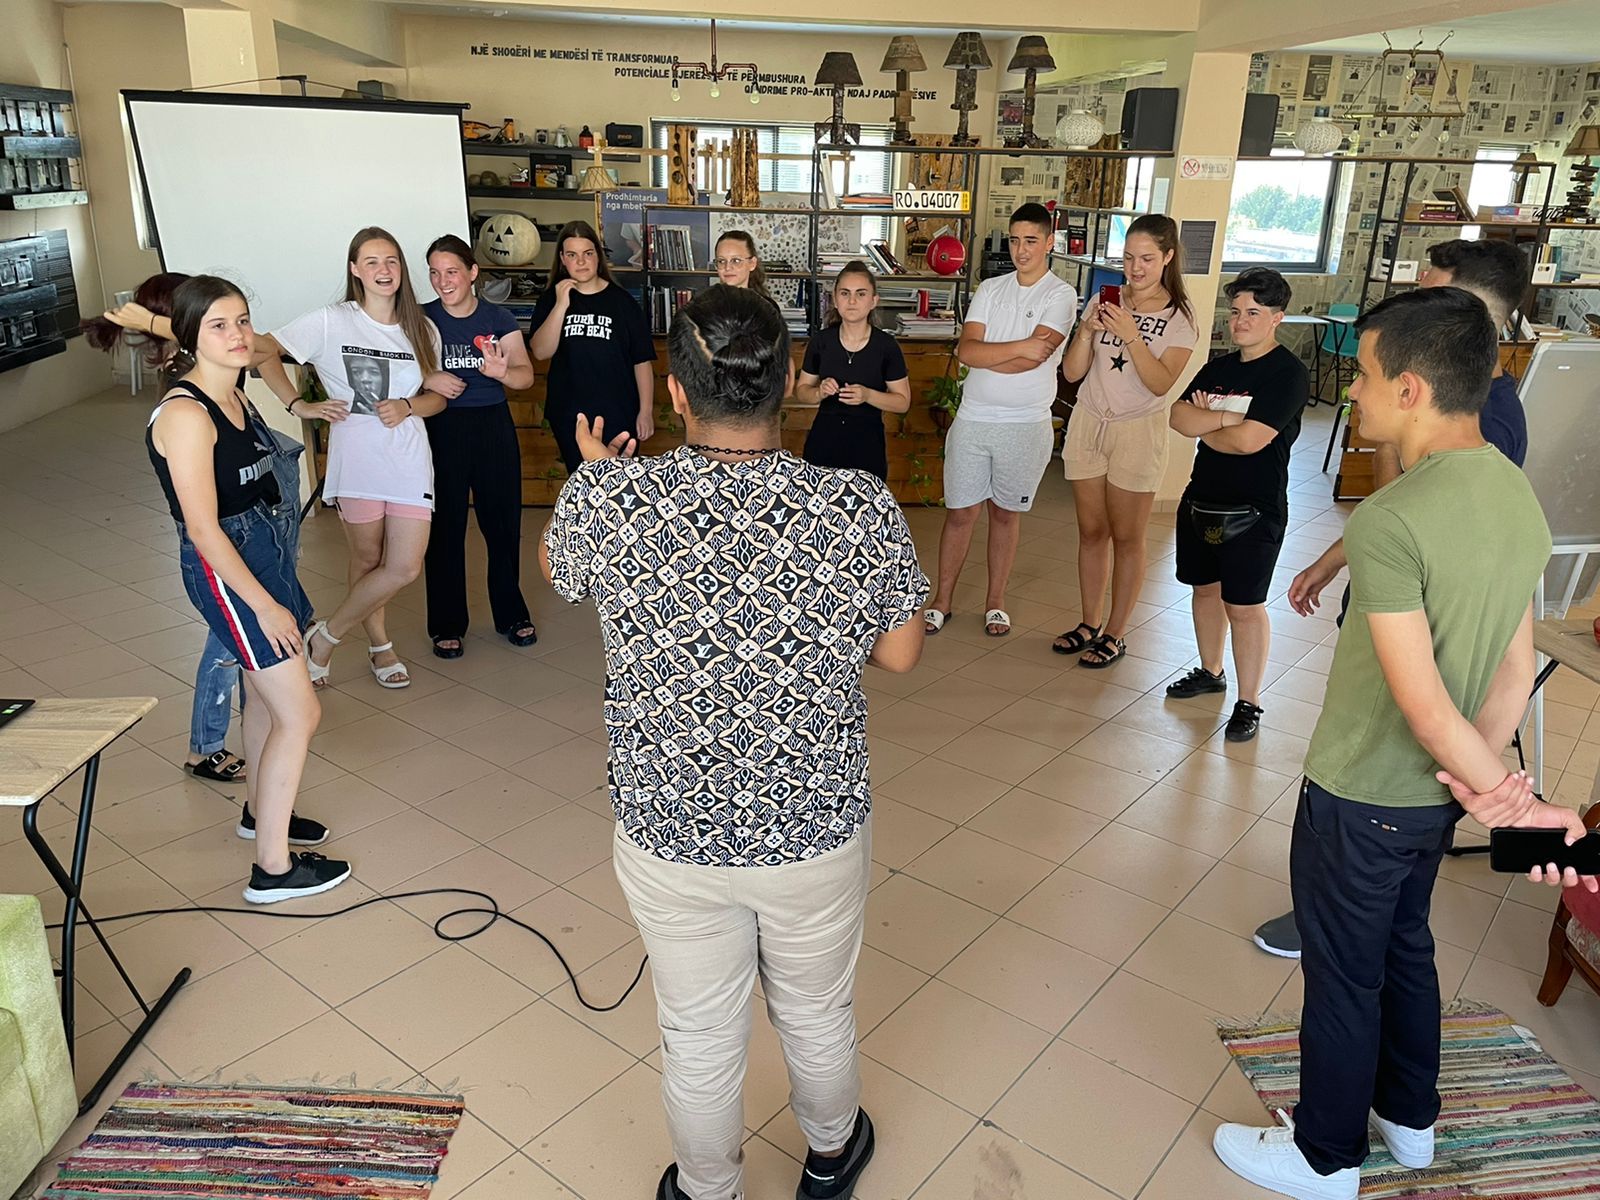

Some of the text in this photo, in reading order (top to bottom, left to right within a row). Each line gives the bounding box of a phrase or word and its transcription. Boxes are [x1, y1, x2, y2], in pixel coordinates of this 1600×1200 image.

[471, 43, 489, 55] NJË
[534, 49, 547, 58] ME
[592, 49, 603, 61] TË
[606, 52, 679, 65] TRANSFORMUAR
[727, 69, 738, 81] TË
[847, 89, 871, 98] NDAJ
[606, 202, 643, 211] nga mbet
[566, 314, 613, 327] TURN UP
[564, 323, 613, 340] THE BEAT
[342, 347, 374, 356] LONDON
[444, 344, 473, 358] LIVE
[444, 357, 485, 369] GENERO
